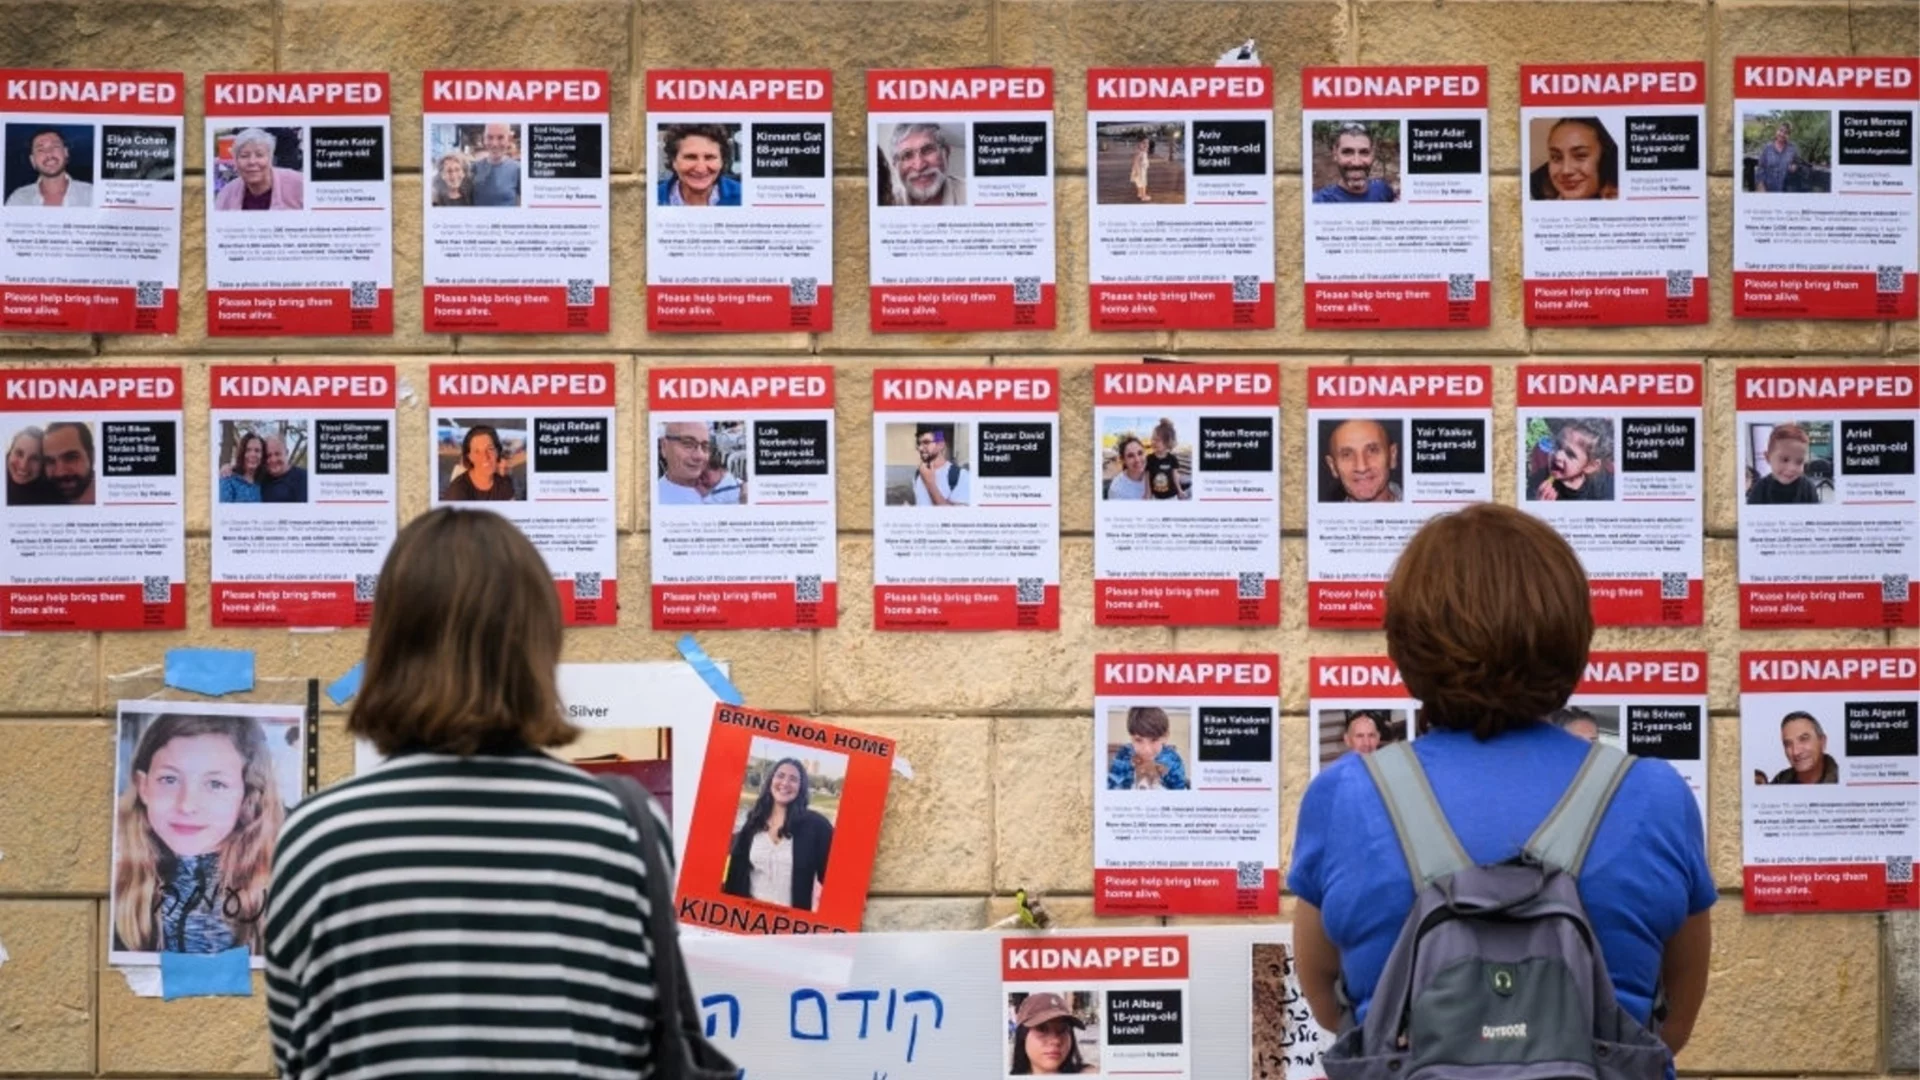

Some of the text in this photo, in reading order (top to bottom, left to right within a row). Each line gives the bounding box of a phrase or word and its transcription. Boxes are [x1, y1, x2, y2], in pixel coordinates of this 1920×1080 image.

[1530, 72, 1697, 94] KIDNAPPED
[1744, 66, 1912, 88] KIDNAPPED
[7, 79, 176, 103] KIDNAPPED
[433, 80, 601, 101] KIDNAPPED
[656, 79, 824, 100] KIDNAPPED
[877, 78, 1045, 99] KIDNAPPED
[1097, 77, 1264, 98] KIDNAPPED
[1312, 75, 1480, 97] KIDNAPPED
[214, 83, 382, 104] KIDNAPPED
[757, 132, 822, 141] Kinneret Gat
[1413, 128, 1465, 137] Tamir Adar
[134, 135, 168, 146] Cohen
[106, 147, 169, 158] 27-years-old
[1197, 143, 1261, 155] 2-years-old
[757, 158, 788, 167] Israeli
[1197, 157, 1230, 167] Israeli
[1413, 152, 1442, 162] Israeli
[1631, 155, 1658, 164] Israeli
[106, 160, 137, 170] Israeli
[4, 292, 119, 305] Please help bring them
[1315, 289, 1430, 301] Please help bring them
[3, 305, 32, 315] home
[1315, 303, 1345, 312] home
[6, 377, 175, 400] KIDNAPPED
[220, 375, 388, 397] KIDNAPPED
[438, 374, 607, 395] KIDNAPPED
[658, 376, 826, 399] KIDNAPPED
[882, 378, 1051, 400] KIDNAPPED
[1104, 373, 1272, 395] KIDNAPPED
[1316, 375, 1484, 397] KIDNAPPED
[1526, 373, 1694, 395] KIDNAPPED
[1746, 376, 1913, 399] KIDNAPPED
[1019, 431, 1045, 440] David
[1846, 428, 1872, 439] Ariel
[1627, 437, 1685, 448] 3-years-old
[1846, 442, 1908, 453] 4-years-old
[539, 446, 569, 455] Israeli
[1417, 452, 1446, 461] Israeli
[1627, 449, 1658, 459] Israeli
[1846, 455, 1880, 466] Israeli
[662, 591, 777, 603] Please help bring them
[663, 604, 691, 614] home
[1104, 663, 1272, 684] KIDNAPPED
[1584, 661, 1700, 683] NAPPED
[1749, 657, 1917, 681] KIDNAPPED
[569, 705, 609, 718] Silver
[718, 708, 890, 757] BRING NOA HOME
[1632, 734, 1662, 743] Israeli
[1850, 732, 1879, 741] Israeli
[1105, 876, 1220, 888] Please help bring them
[1105, 889, 1133, 898] home
[679, 897, 849, 935] KIDNAPP
[1009, 947, 1180, 969] KIDNAPPED
[790, 988, 944, 1063] קודם
[1113, 1024, 1144, 1034] Israeli
[1482, 1023, 1527, 1039] OUTDOOR
